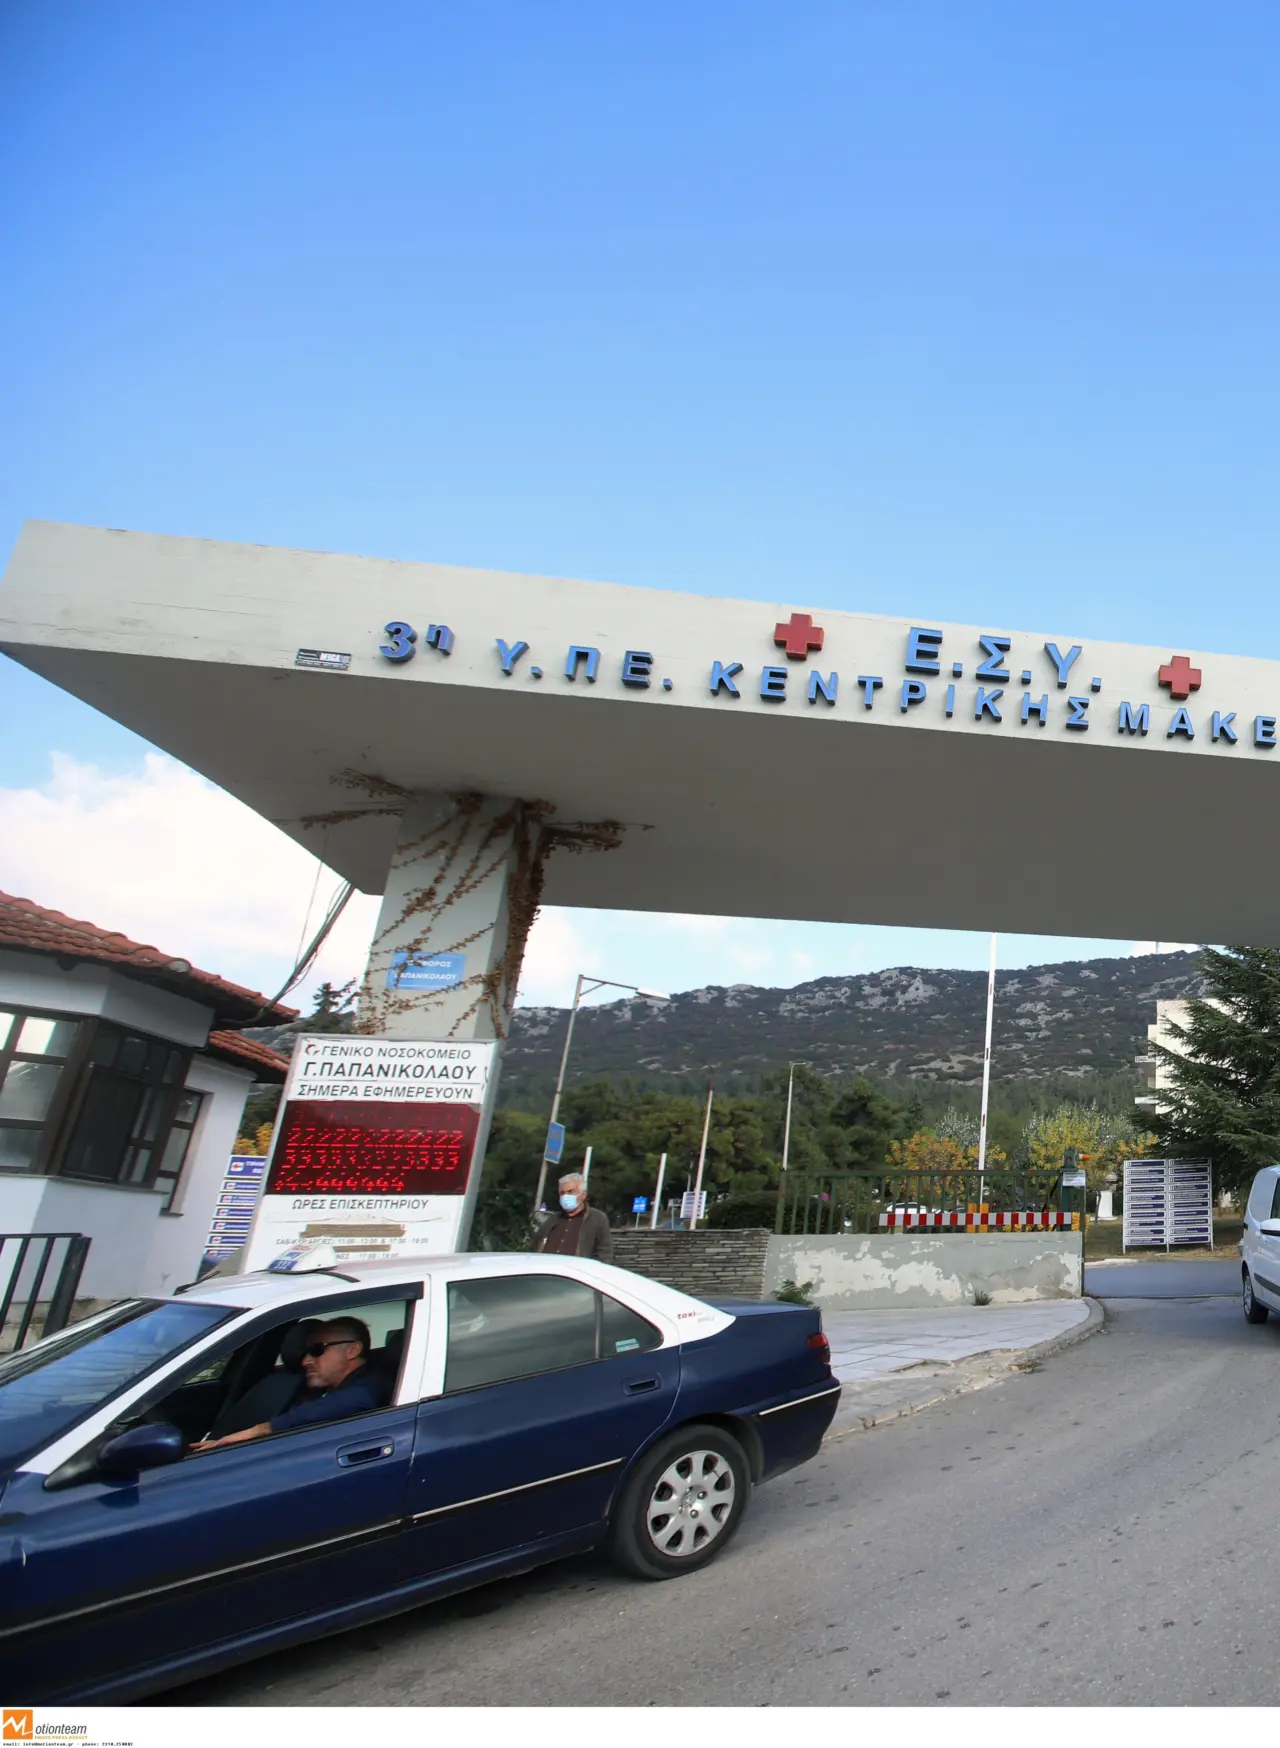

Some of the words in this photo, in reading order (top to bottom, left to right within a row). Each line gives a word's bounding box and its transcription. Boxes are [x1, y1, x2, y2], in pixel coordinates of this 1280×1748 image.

[905, 626, 1102, 692] Ε.Σ.Υ.
[379, 621, 456, 664] 3η
[709, 660, 1091, 730] ΚΕΝΤΡΙΚΗΣ
[321, 1045, 374, 1057] ΓΕΝΙΚΟ
[377, 1047, 471, 1060] ΝΟΣΟΚΟΜΕΙΟ
[303, 1061, 477, 1080] Γ.ΠΑΠΑΝΙΚΟΛΑΟΥ
[298, 1084, 359, 1097] ΣΗΜΕΡΑ
[363, 1086, 474, 1099] ΕΦΗΜΕΡΕΥΟΥΝ
[292, 1199, 326, 1210] ΩΡΕΣ
[330, 1199, 429, 1210] ΕΠΙΣΚΕΠΤΗΡΙΟΥ
[677, 1310, 696, 1320] taxi
